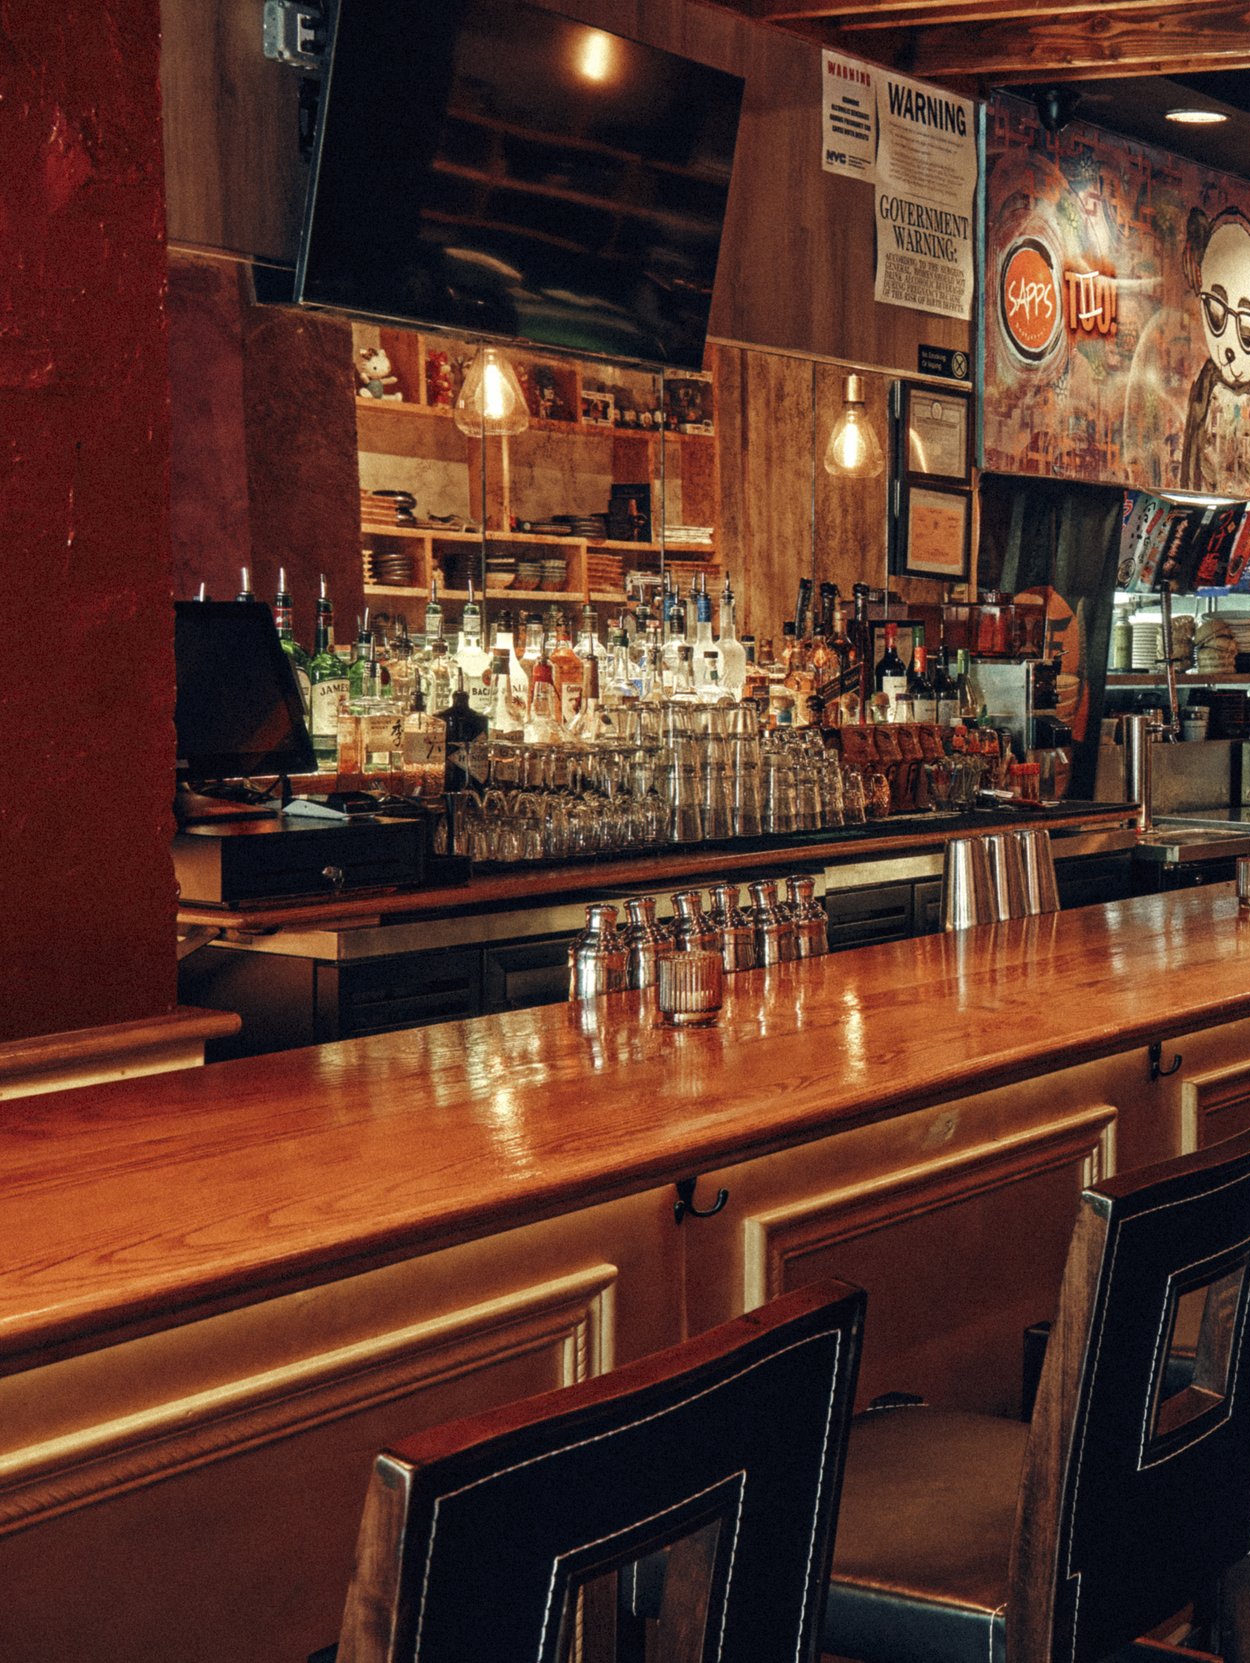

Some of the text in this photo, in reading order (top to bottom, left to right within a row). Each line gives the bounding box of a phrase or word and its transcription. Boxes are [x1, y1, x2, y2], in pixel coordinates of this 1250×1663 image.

[827, 61, 871, 87] WARNING
[888, 81, 966, 137] WARNING
[826, 149, 847, 164] NYC
[880, 194, 968, 240] GOVERNMENT
[893, 224, 957, 263] WARNING:
[1008, 277, 1053, 320] SAPPS
